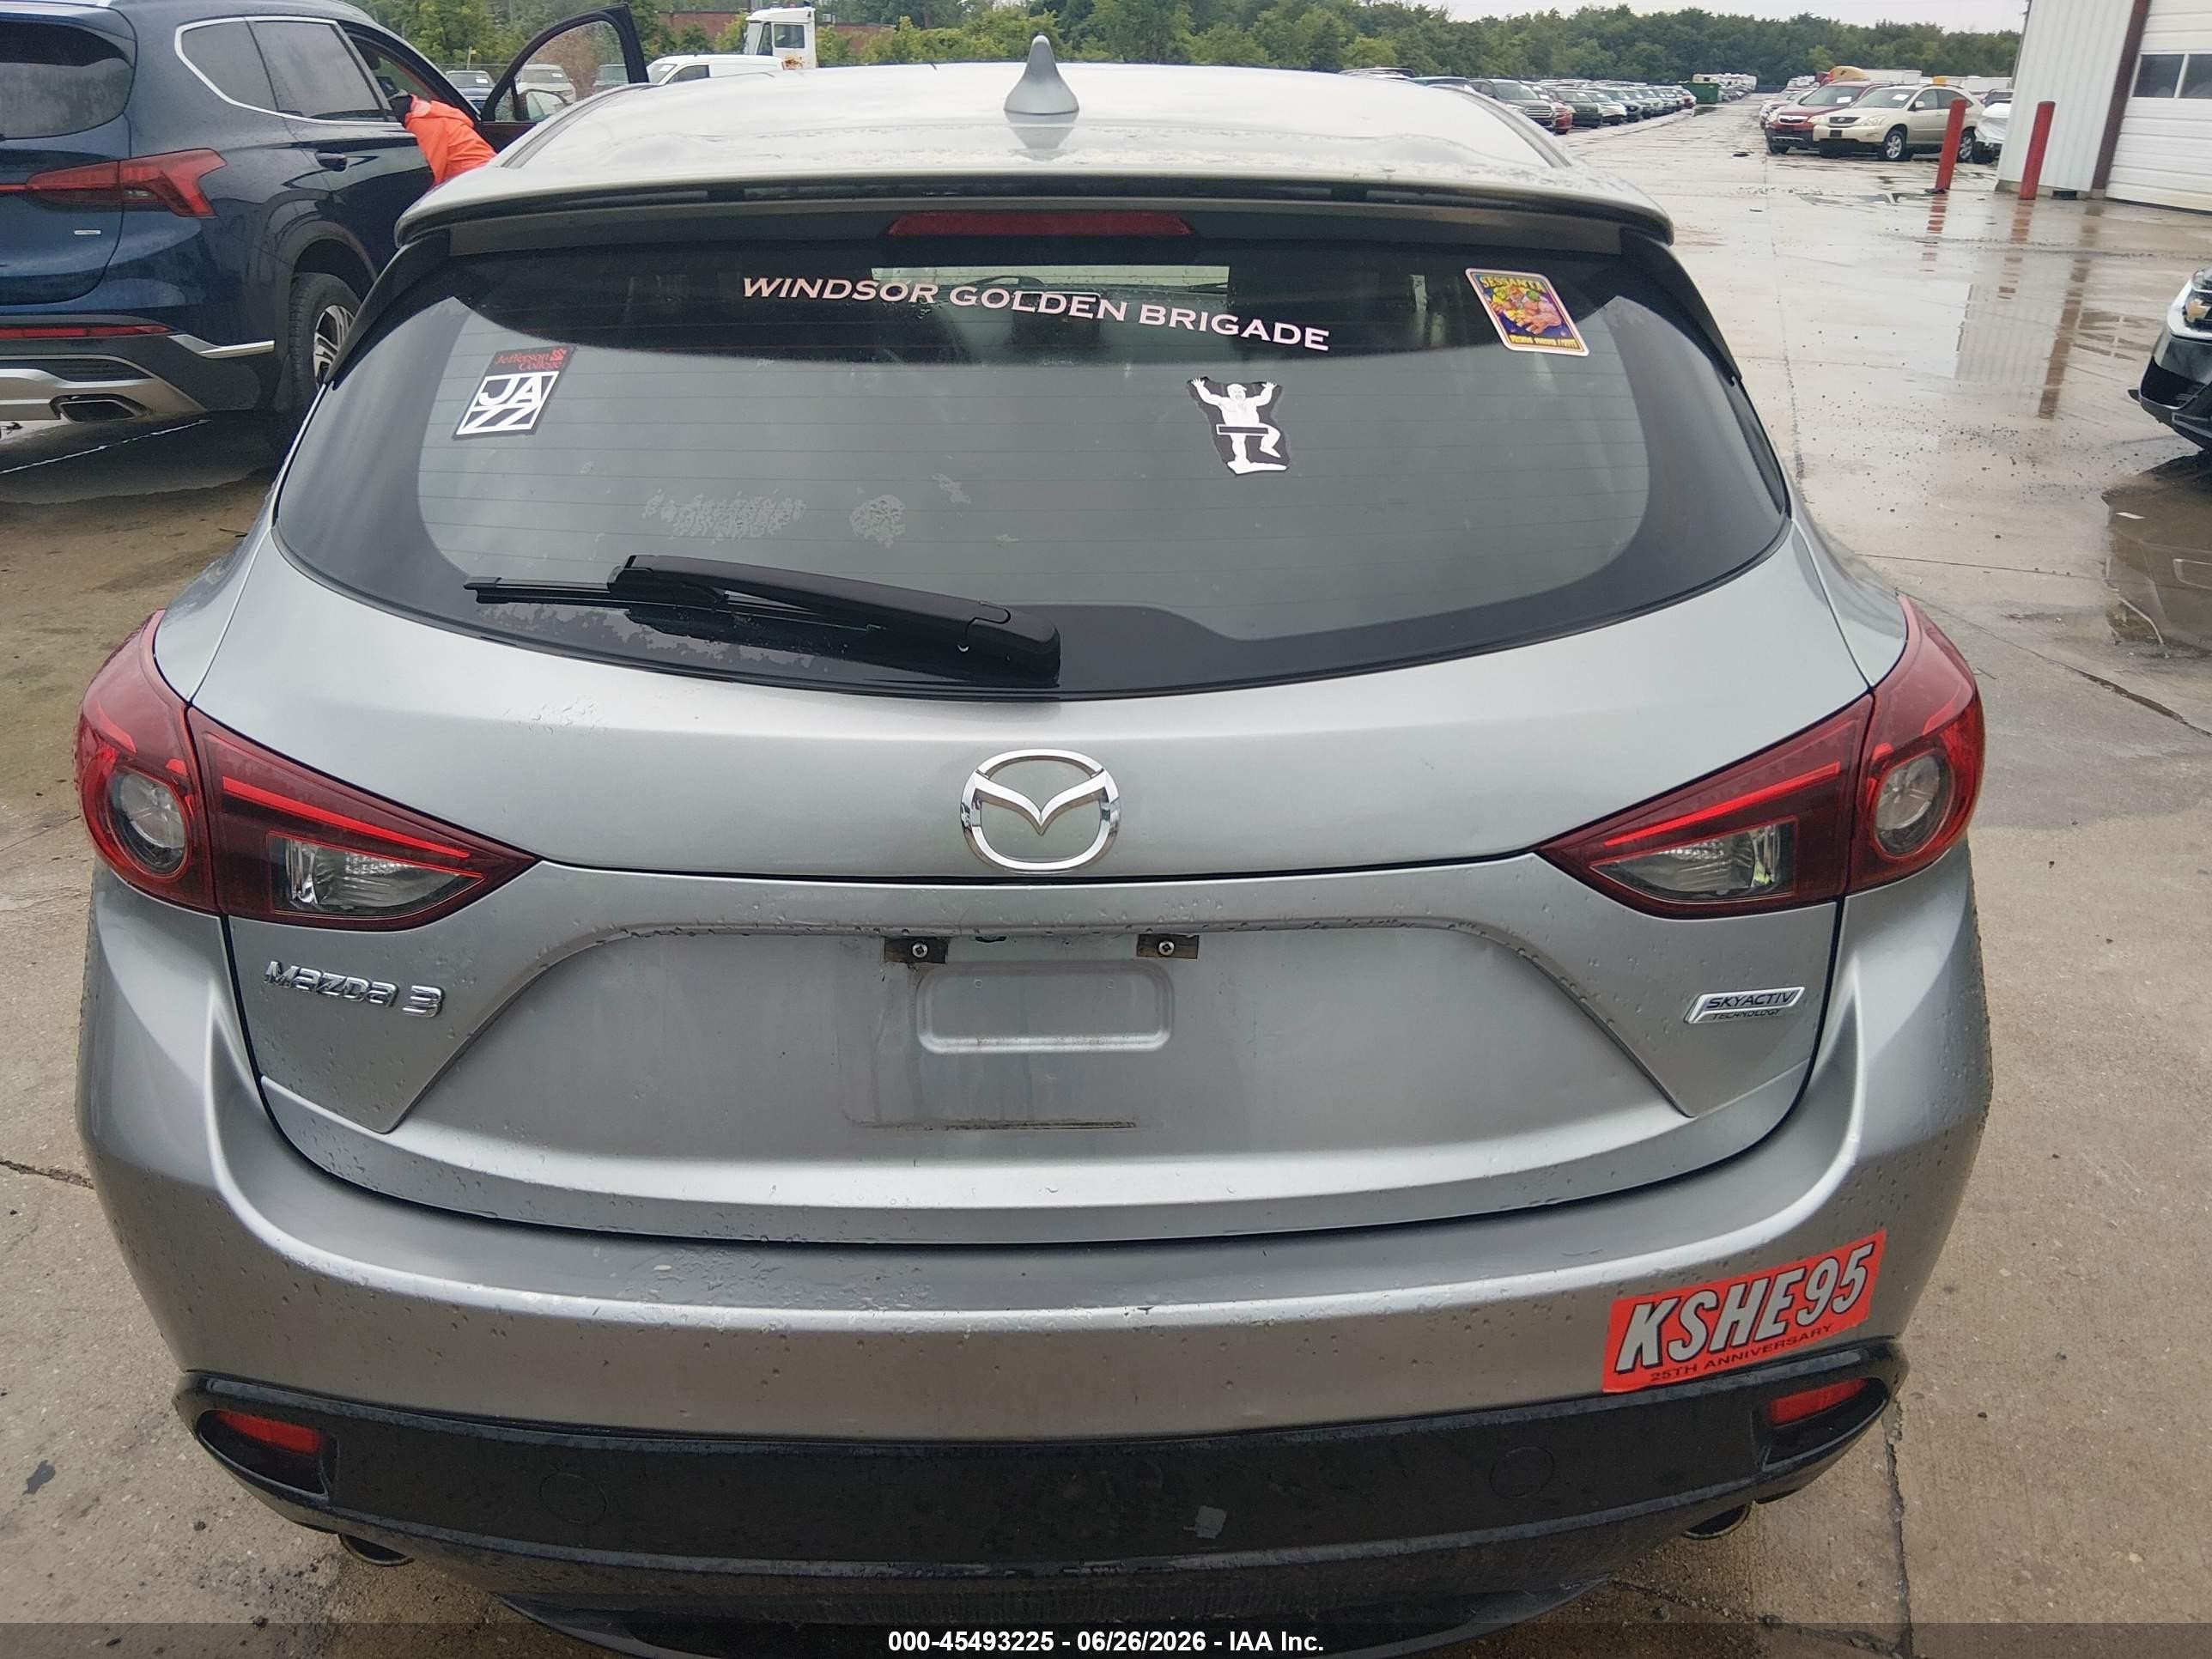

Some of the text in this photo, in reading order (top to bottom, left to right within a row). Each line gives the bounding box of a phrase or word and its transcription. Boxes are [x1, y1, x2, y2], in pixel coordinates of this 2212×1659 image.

[743, 276, 1330, 352] WINDSOR GOLDEN BRIGADE
[402, 985, 446, 1017] 3
[1706, 992, 1795, 1008] SKYACTIV
[1713, 1009, 1781, 1020] TECHNOLOGY
[1650, 1325, 1833, 1382] 25TH ANNIVERSARY
